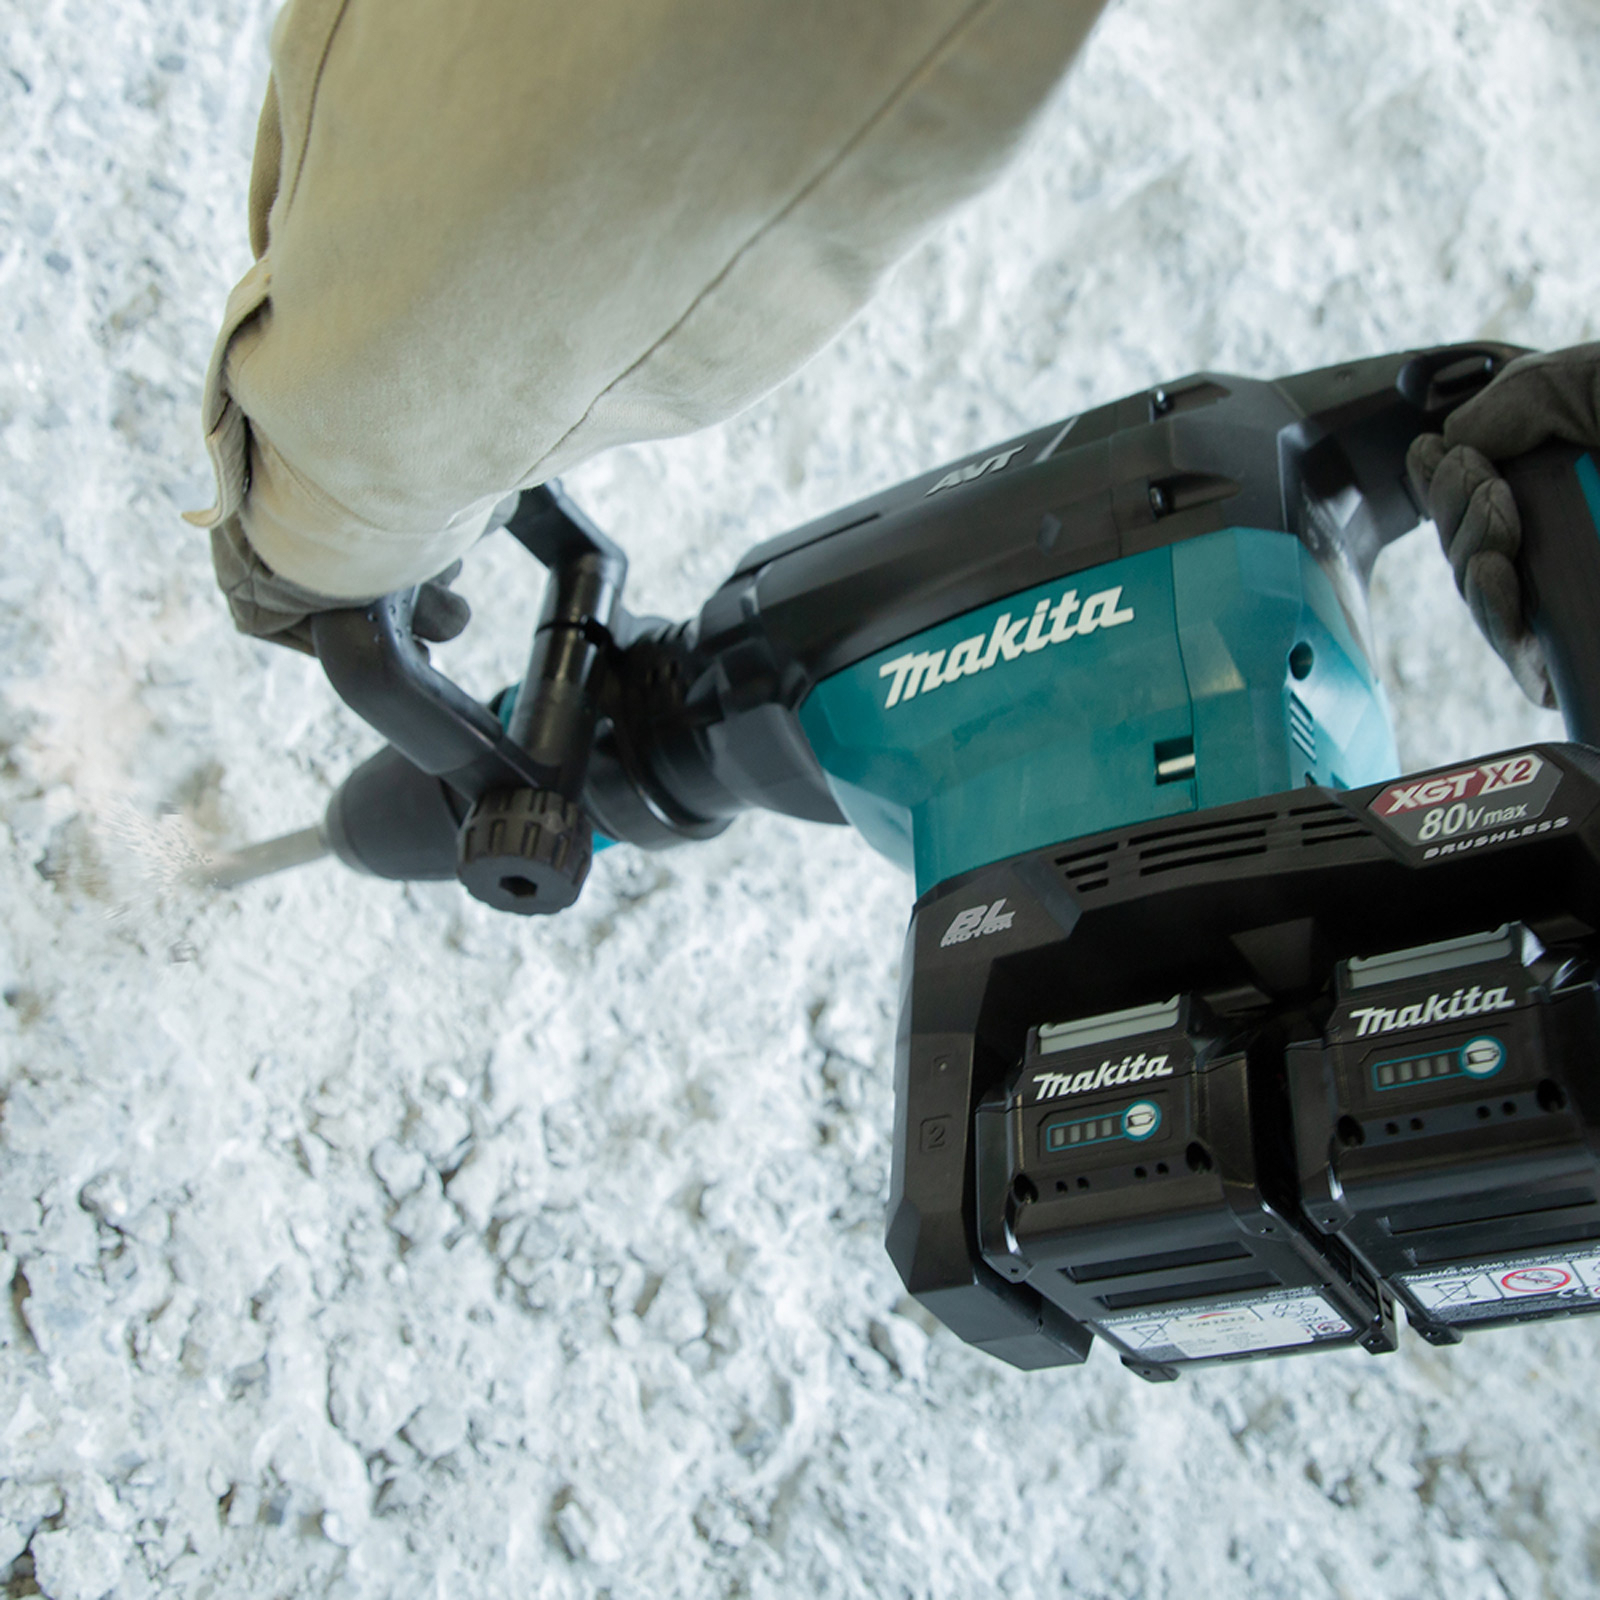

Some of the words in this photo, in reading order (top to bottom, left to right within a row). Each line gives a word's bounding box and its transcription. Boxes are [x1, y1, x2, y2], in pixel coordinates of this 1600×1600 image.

[1384, 771, 1477, 815] XGT
[1423, 816, 1570, 860] BRUSHLESS
[944, 898, 1016, 936] BL
